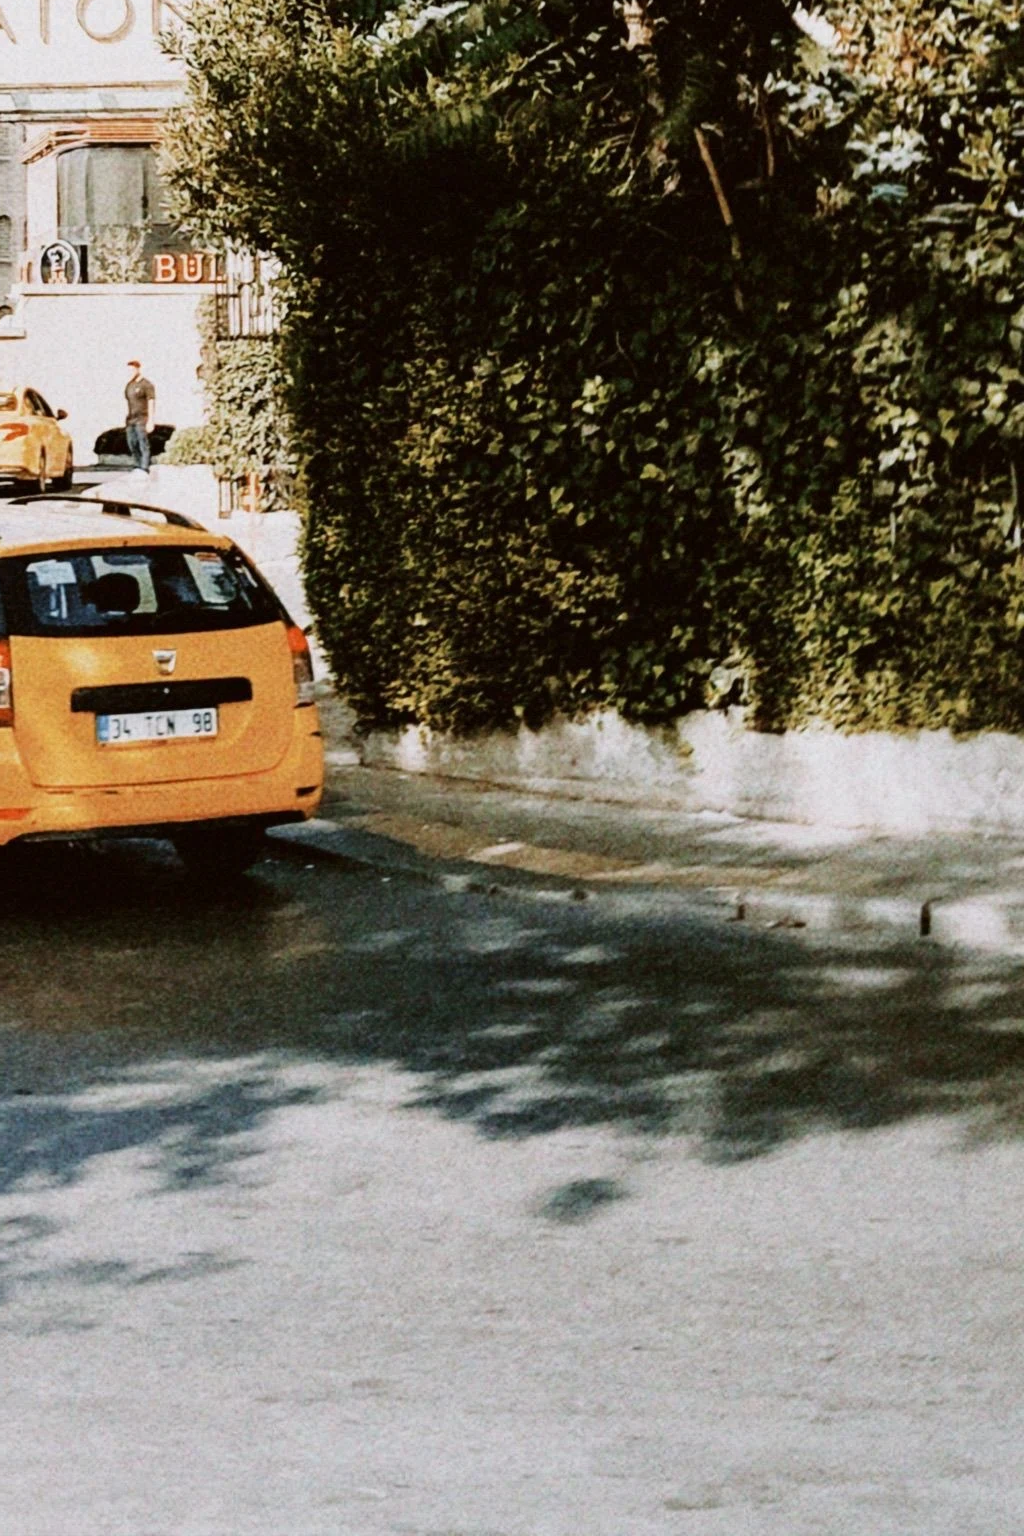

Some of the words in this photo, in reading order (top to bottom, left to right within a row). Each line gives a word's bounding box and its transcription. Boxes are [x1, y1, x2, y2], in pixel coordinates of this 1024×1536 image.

[111, 718, 131, 739] 34
[145, 714, 176, 737] TCN
[192, 711, 213, 733] 98
